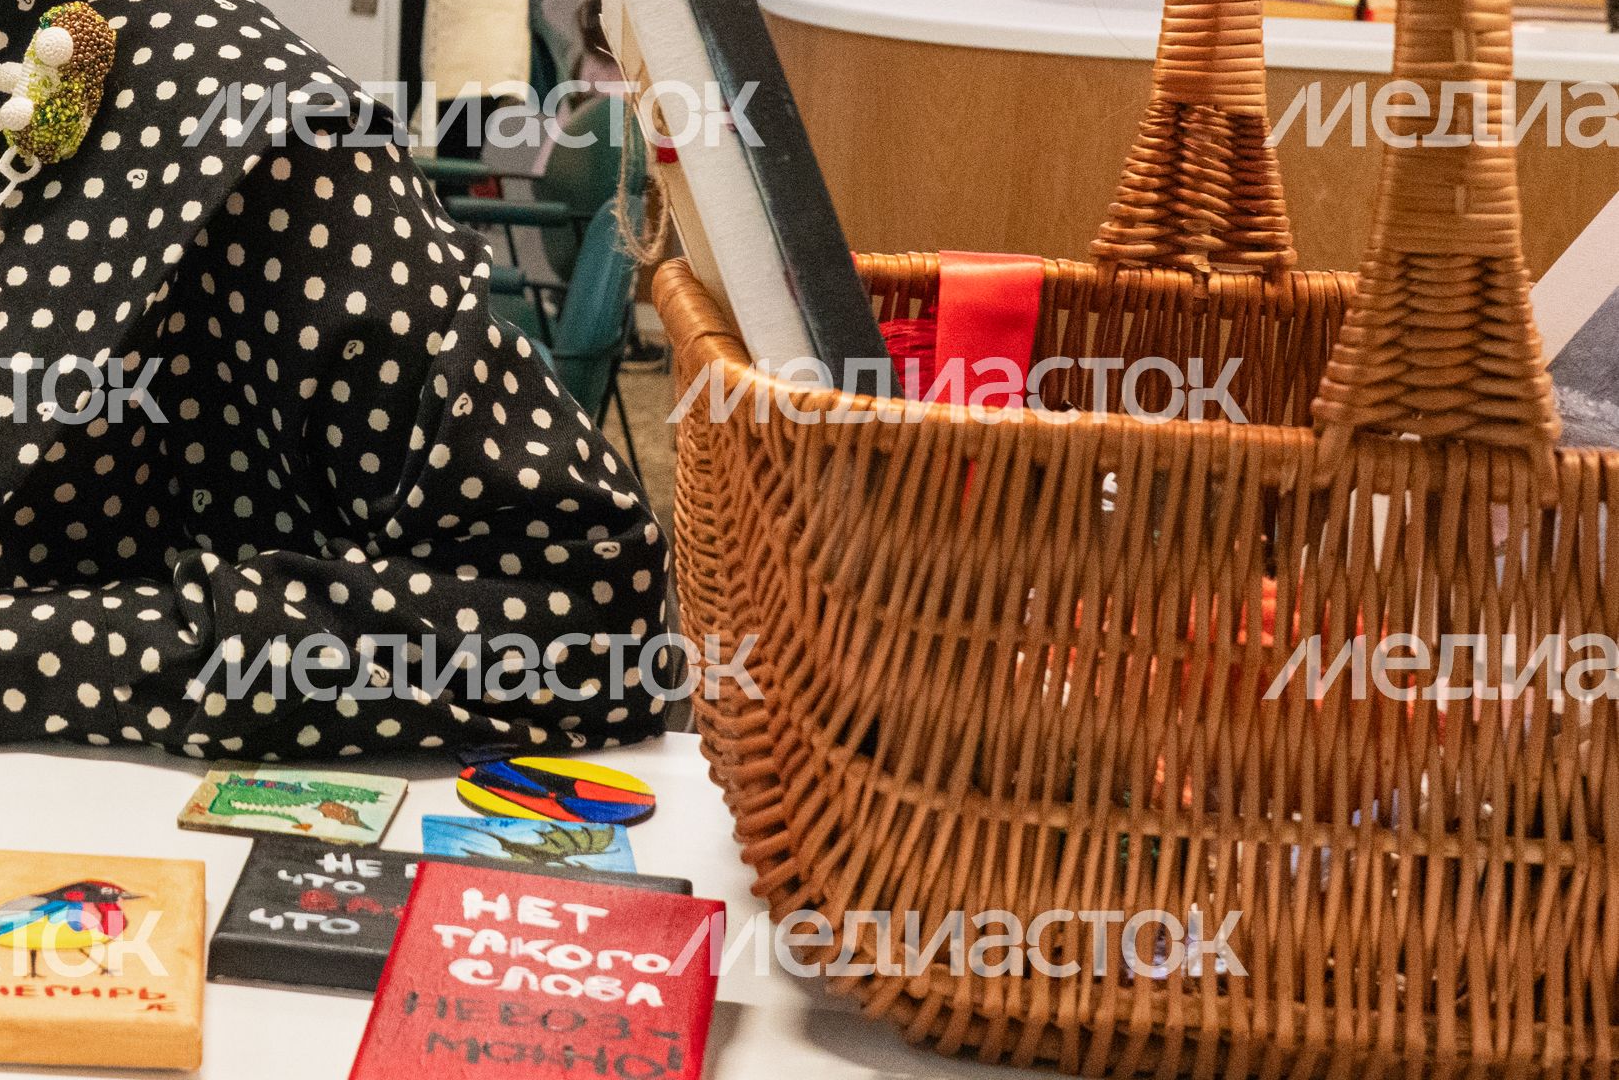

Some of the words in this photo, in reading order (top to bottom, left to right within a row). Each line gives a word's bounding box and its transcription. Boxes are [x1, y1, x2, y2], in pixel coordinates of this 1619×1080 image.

[277, 870, 366, 894] ЧТО
[316, 852, 382, 878] НЕ
[249, 908, 361, 934] ЧТО
[462, 887, 609, 934] НЕТ
[432, 924, 672, 973] ТАКОГО
[448, 957, 664, 1007] СЛОВА
